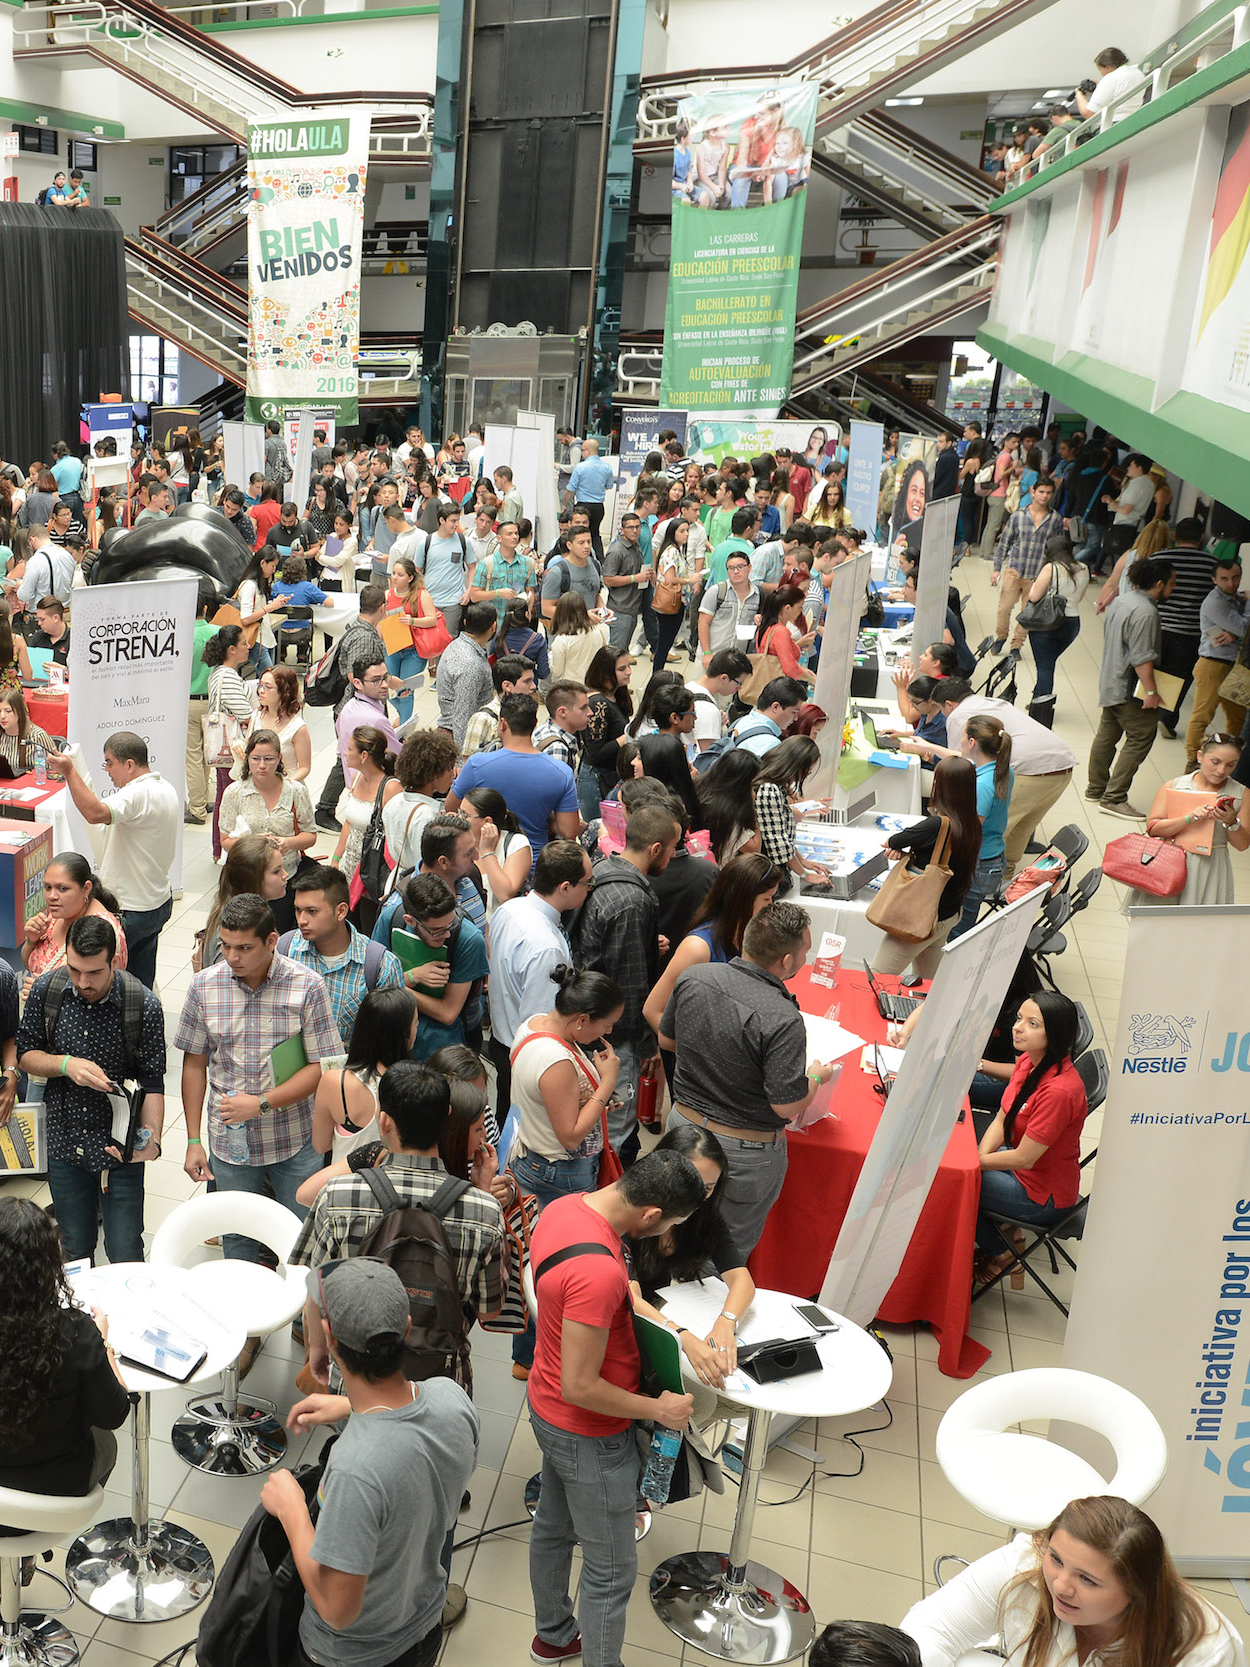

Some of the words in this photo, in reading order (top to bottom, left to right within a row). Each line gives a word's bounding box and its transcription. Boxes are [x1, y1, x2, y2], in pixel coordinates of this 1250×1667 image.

[250, 125, 342, 153] #HOLAULA
[259, 218, 340, 263] BIEN
[710, 235, 722, 245] LAS
[724, 232, 758, 244] CARRERAS
[694, 248, 728, 258] LICENCIATURA
[729, 247, 736, 255] EN
[737, 246, 759, 255] CIENCIAS
[761, 245, 767, 253] DE
[257, 245, 352, 282] VENIDOS
[673, 257, 729, 277] EDUCACIÓN
[732, 255, 794, 273] PREESCOLAR
[696, 295, 757, 311] BACHILLERATO
[760, 295, 771, 307] EN
[681, 311, 728, 327] EDUCACIÓN
[731, 309, 783, 324] PREESCOLAR
[703, 331, 710, 339] EN
[711, 330, 717, 338] LA
[702, 357, 723, 366] INICIAN
[724, 356, 750, 365] PROCESO
[752, 356, 760, 364] DE
[689, 361, 771, 380] AUTOEVALUACIÓN
[316, 376, 355, 392] 2016
[711, 380, 723, 389] CON
[724, 380, 739, 388] FINES
[669, 388, 731, 405] ACREDITACIÓN
[734, 389, 757, 403] ANTE
[627, 432, 648, 442] WE
[131, 611, 155, 619] PARTE
[89, 616, 176, 638] CORPORACIÓN
[89, 632, 180, 665] STRENA,
[144, 659, 174, 669] importante
[113, 695, 150, 708] MaxMara
[96, 720, 124, 730] ADOLFO
[25, 843, 49, 878] WORK
[1130, 1112, 1250, 1125] #IniciativaPorL
[1222, 1199, 1250, 1242] los
[1219, 1252, 1250, 1300] por
[1186, 1309, 1242, 1441] iniciativa
